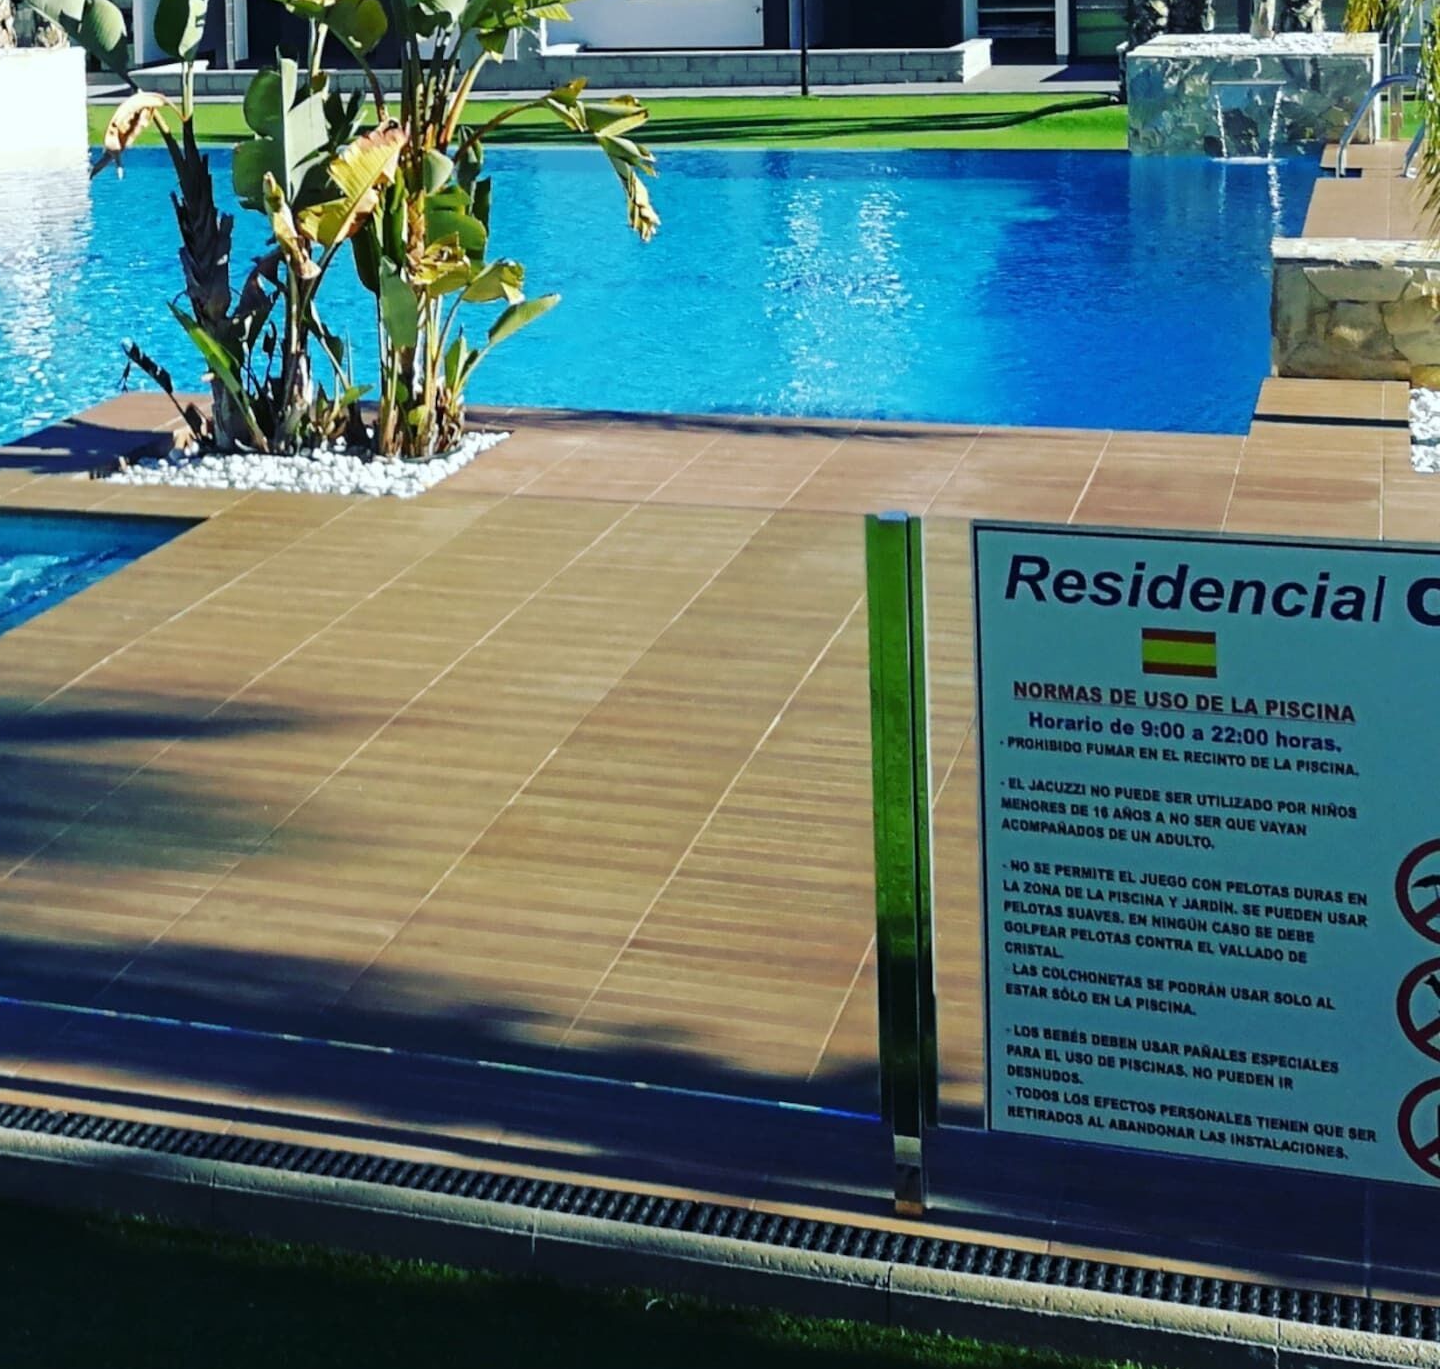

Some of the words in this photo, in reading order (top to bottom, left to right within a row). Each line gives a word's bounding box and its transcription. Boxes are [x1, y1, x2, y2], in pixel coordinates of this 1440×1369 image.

[1004, 555, 1387, 621] Residencial
[1013, 681, 1102, 704] NORMAS
[1109, 688, 1136, 706] DE
[1143, 690, 1188, 709] USO
[1195, 693, 1224, 713] DE
[1231, 696, 1258, 715] LA
[1265, 699, 1355, 721] PISCINA
[1028, 710, 1104, 733] Horario
[1109, 717, 1135, 735] de
[1139, 719, 1185, 739] 9:00
[1191, 727, 1204, 741] a
[1210, 724, 1269, 746] 22:00
[1275, 729, 1342, 752] horas.
[1007, 736, 1082, 753] PROHIBIDO
[1085, 742, 1135, 758] FUMAR
[1138, 746, 1158, 760] EN
[1161, 747, 1180, 761] EL
[1183, 750, 1246, 767] RECINTO
[1250, 755, 1270, 769] DE
[1273, 756, 1292, 770] LA
[1000, 796, 1066, 814] MENORES
[1070, 803, 1089, 817] DE
[1092, 805, 1110, 819] 16
[1112, 805, 1152, 822] AÑOS
[1154, 810, 1166, 825] A
[1169, 811, 1190, 826] NO
[1193, 814, 1222, 829] SER
[1224, 817, 1256, 831] QUE
[1259, 819, 1307, 835] VAYAN
[1008, 777, 1025, 790] EL
[1027, 779, 1086, 795] JACUZZI
[1090, 784, 1111, 798] NO
[1114, 786, 1160, 802] PUEDE
[1164, 791, 1192, 805] SER
[1196, 794, 1274, 811] UTILIZADO
[1276, 800, 1306, 814] POR
[1311, 802, 1357, 818] NIÑOS
[1001, 818, 1105, 838] ACOMPAÑADOS
[1108, 827, 1129, 841] DE
[1130, 828, 1152, 843] UN
[1154, 832, 1215, 849] ADULTO.
[1002, 878, 1020, 893] LA
[1022, 880, 1061, 897] ZONA
[1064, 884, 1084, 899] DE
[1086, 887, 1105, 901] LA
[1108, 889, 1165, 907] PISCINA
[1168, 895, 1180, 908] Y
[1240, 902, 1261, 917] SE
[1262, 903, 1323, 922] PUEDEN
[1327, 911, 1368, 927] USAR
[1010, 859, 1030, 873] NO
[1033, 861, 1051, 875] SE
[1054, 864, 1115, 881] PERMITE
[1118, 870, 1136, 883] EL
[1139, 873, 1187, 888] JUEGO
[1191, 877, 1221, 891] CON
[1225, 881, 1289, 898] PELOTAS
[1293, 887, 1343, 903] DURAS
[1347, 892, 1367, 905] EN
[1003, 899, 1064, 917] PELOTAS
[1066, 906, 1125, 924] SUAVES.
[1128, 912, 1147, 927] EN
[1209, 919, 1250, 936] CASO
[1254, 925, 1272, 939] SE
[1276, 927, 1315, 943] DEBE
[1003, 920, 1066, 938] GOLPEAR
[1069, 927, 1131, 945] PELOTAS
[1135, 934, 1193, 951] CONTRA
[1197, 940, 1217, 954] EL
[1218, 942, 1284, 961] VALLADO
[1287, 949, 1307, 963] DE
[1005, 982, 1048, 999] ESTAR
[1091, 991, 1110, 1006] EN
[1113, 994, 1132, 1008] LA
[1012, 962, 1038, 977] LAS
[1040, 965, 1143, 989] COLCHONETAS
[1146, 977, 1164, 993] SE
[1229, 987, 1270, 1003] USAR
[1273, 991, 1313, 1007] SOLO
[1315, 996, 1335, 1010] AL
[1006, 1043, 1042, 1059] PARA
[1044, 1047, 1061, 1062] EL
[1064, 1050, 1093, 1065] USO
[1096, 1054, 1115, 1068] DE
[1191, 1064, 1214, 1079] NO
[1216, 1068, 1274, 1087] PUEDEN
[1278, 1075, 1293, 1090] IR
[1013, 1024, 1040, 1039] LOS
[1090, 1033, 1137, 1050] DEBEN
[1141, 1039, 1181, 1055] USAR
[1183, 1044, 1247, 1063] PAÑALES
[1251, 1052, 1339, 1073] ESPECIALES
[1007, 1063, 1084, 1084] DESNUDOS.
[1007, 1105, 1084, 1125] RETIRADOS
[1087, 1114, 1105, 1129] AL
[1108, 1118, 1195, 1139] ABANDONAR
[1199, 1128, 1226, 1144] LAS
[1230, 1132, 1348, 1159] INSTALACIONES.
[1015, 1085, 1061, 1103] TODOS
[1061, 1091, 1090, 1107] LOS
[1093, 1095, 1156, 1115] EFECTOS
[1159, 1104, 1252, 1126] PERSONALES
[1254, 1115, 1309, 1133] TIENEN
[1312, 1123, 1344, 1138] QUE
[1348, 1127, 1376, 1142] SER
